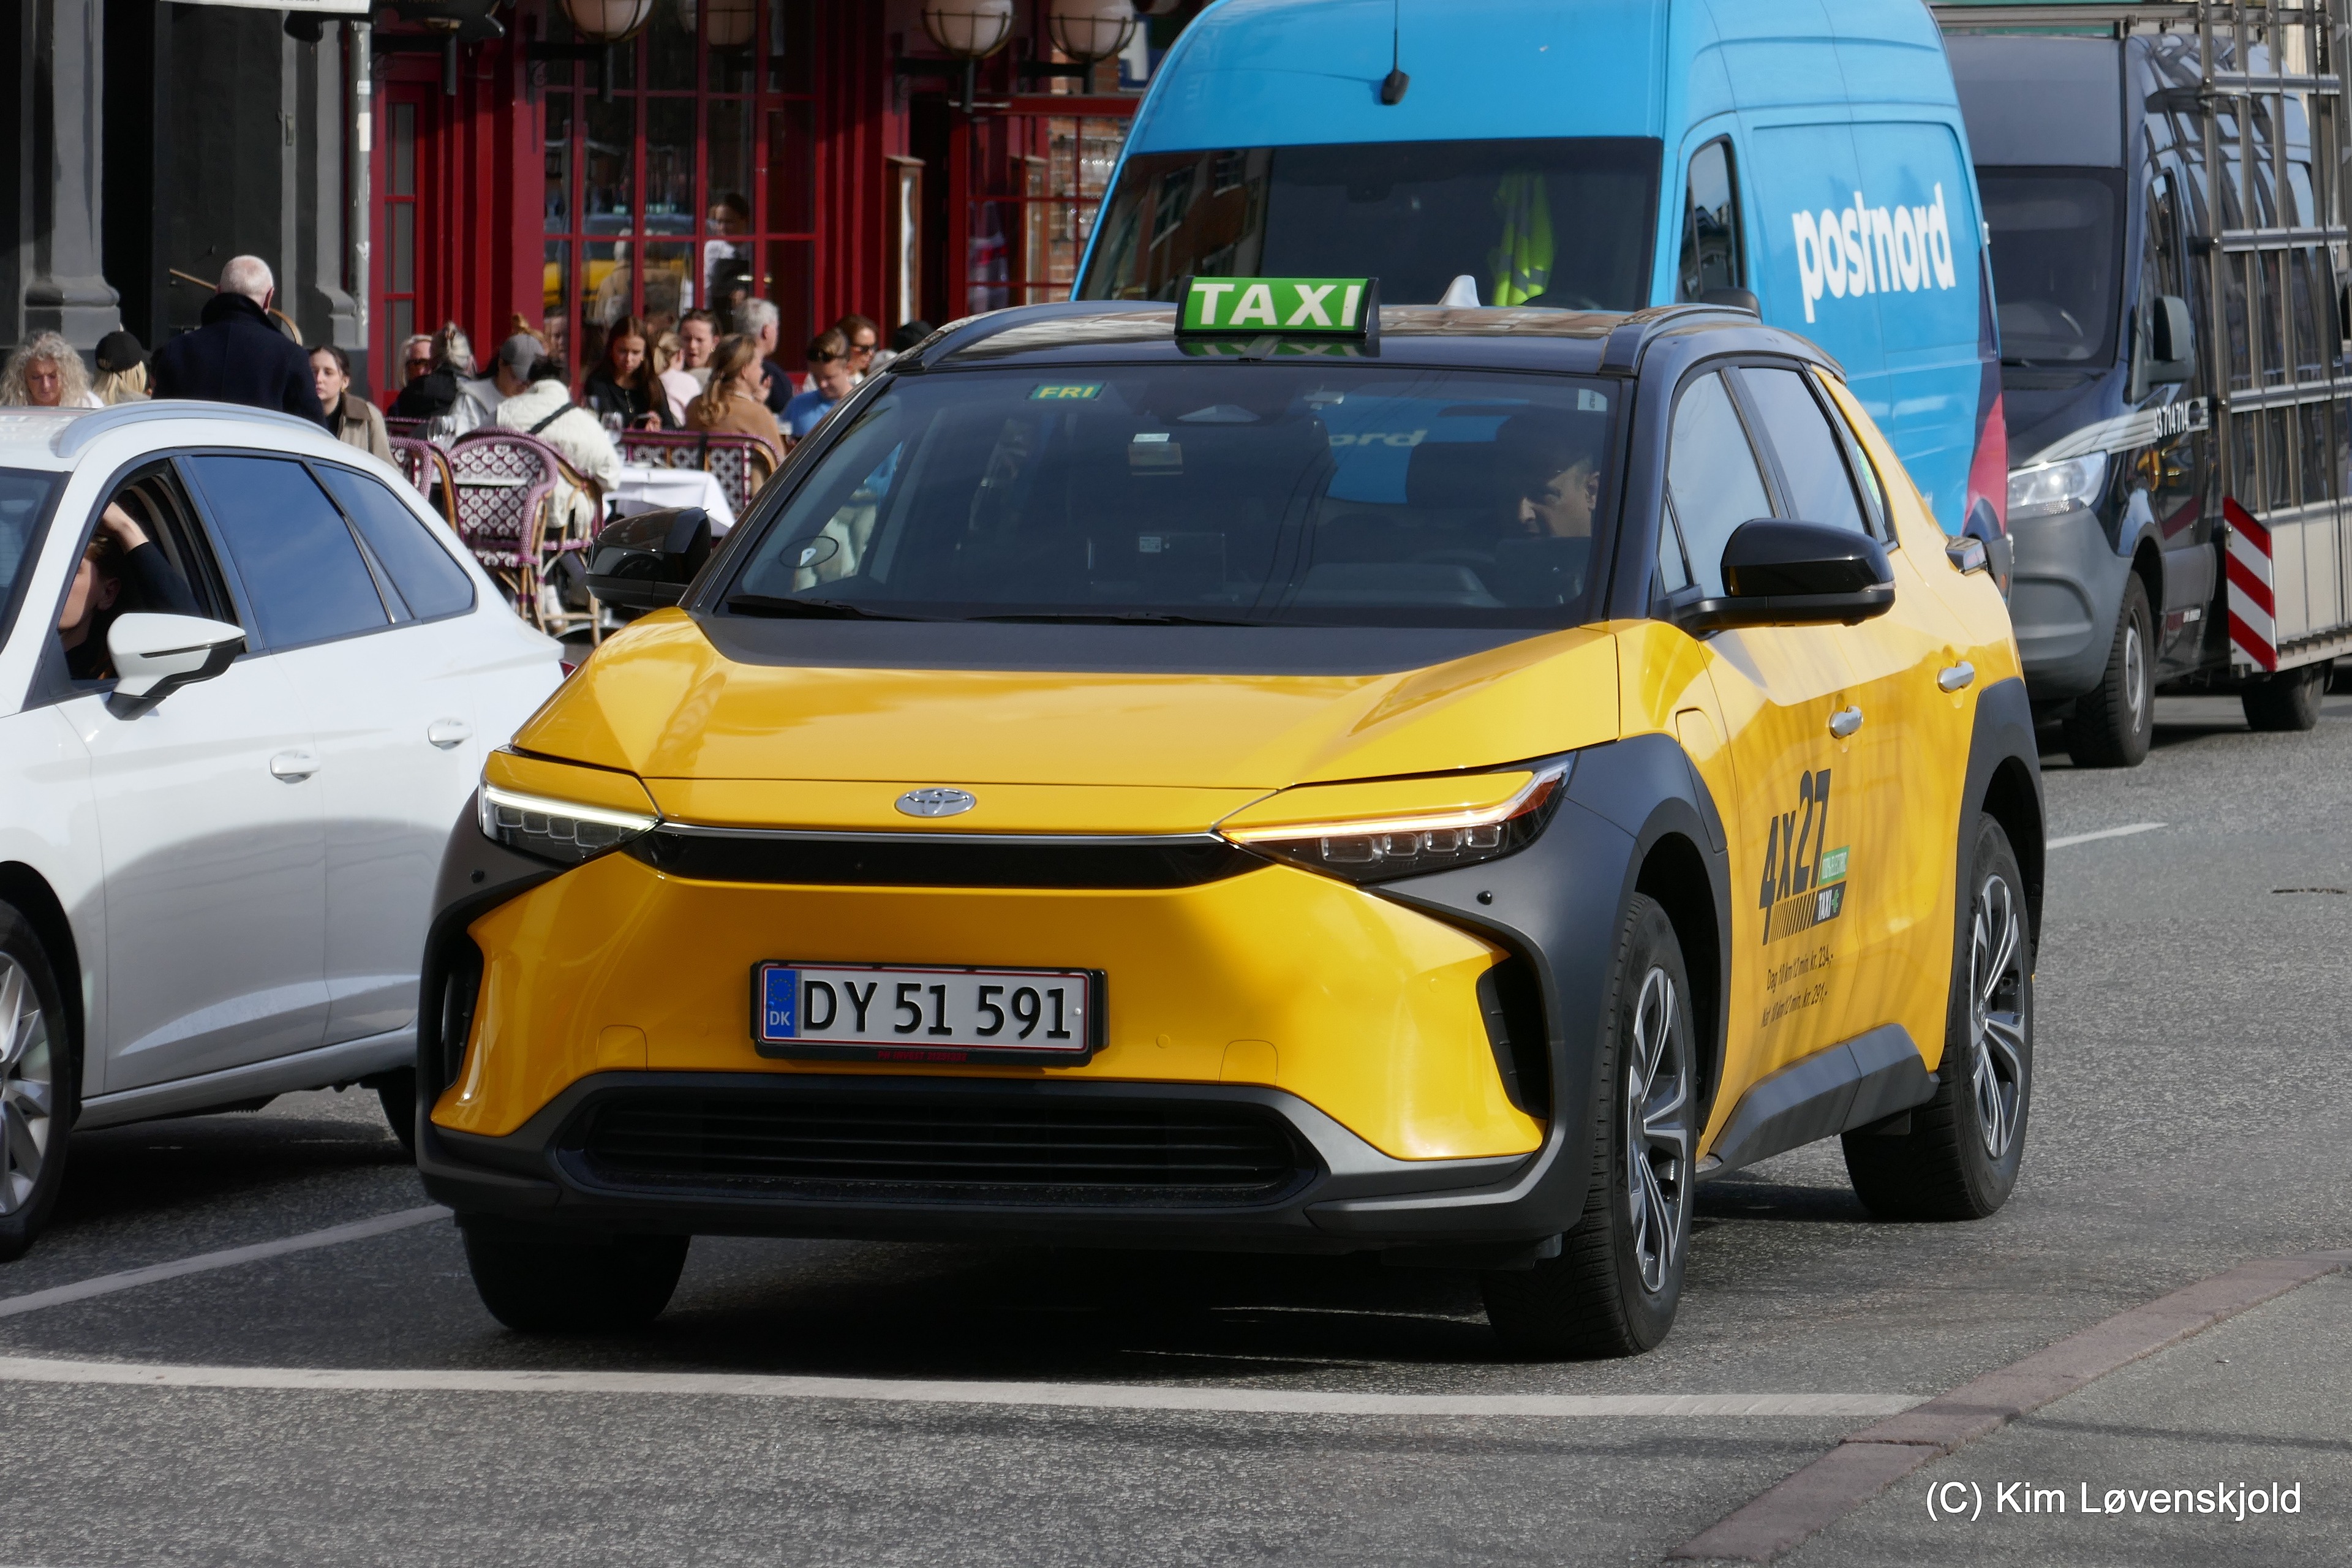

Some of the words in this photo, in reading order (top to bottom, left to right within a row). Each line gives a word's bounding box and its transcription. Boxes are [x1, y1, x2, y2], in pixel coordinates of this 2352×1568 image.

[1792, 181, 1956, 323] postnord
[1192, 284, 1361, 326] TAXI
[1038, 386, 1094, 398] FRI
[1818, 889, 1832, 921] TAXI
[1766, 968, 1777, 994] Dag
[804, 981, 878, 1032] DY
[894, 982, 952, 1036] 51
[976, 984, 1071, 1039] 591
[1801, 987, 1811, 1008] kr.
[769, 1011, 790, 1026] DK
